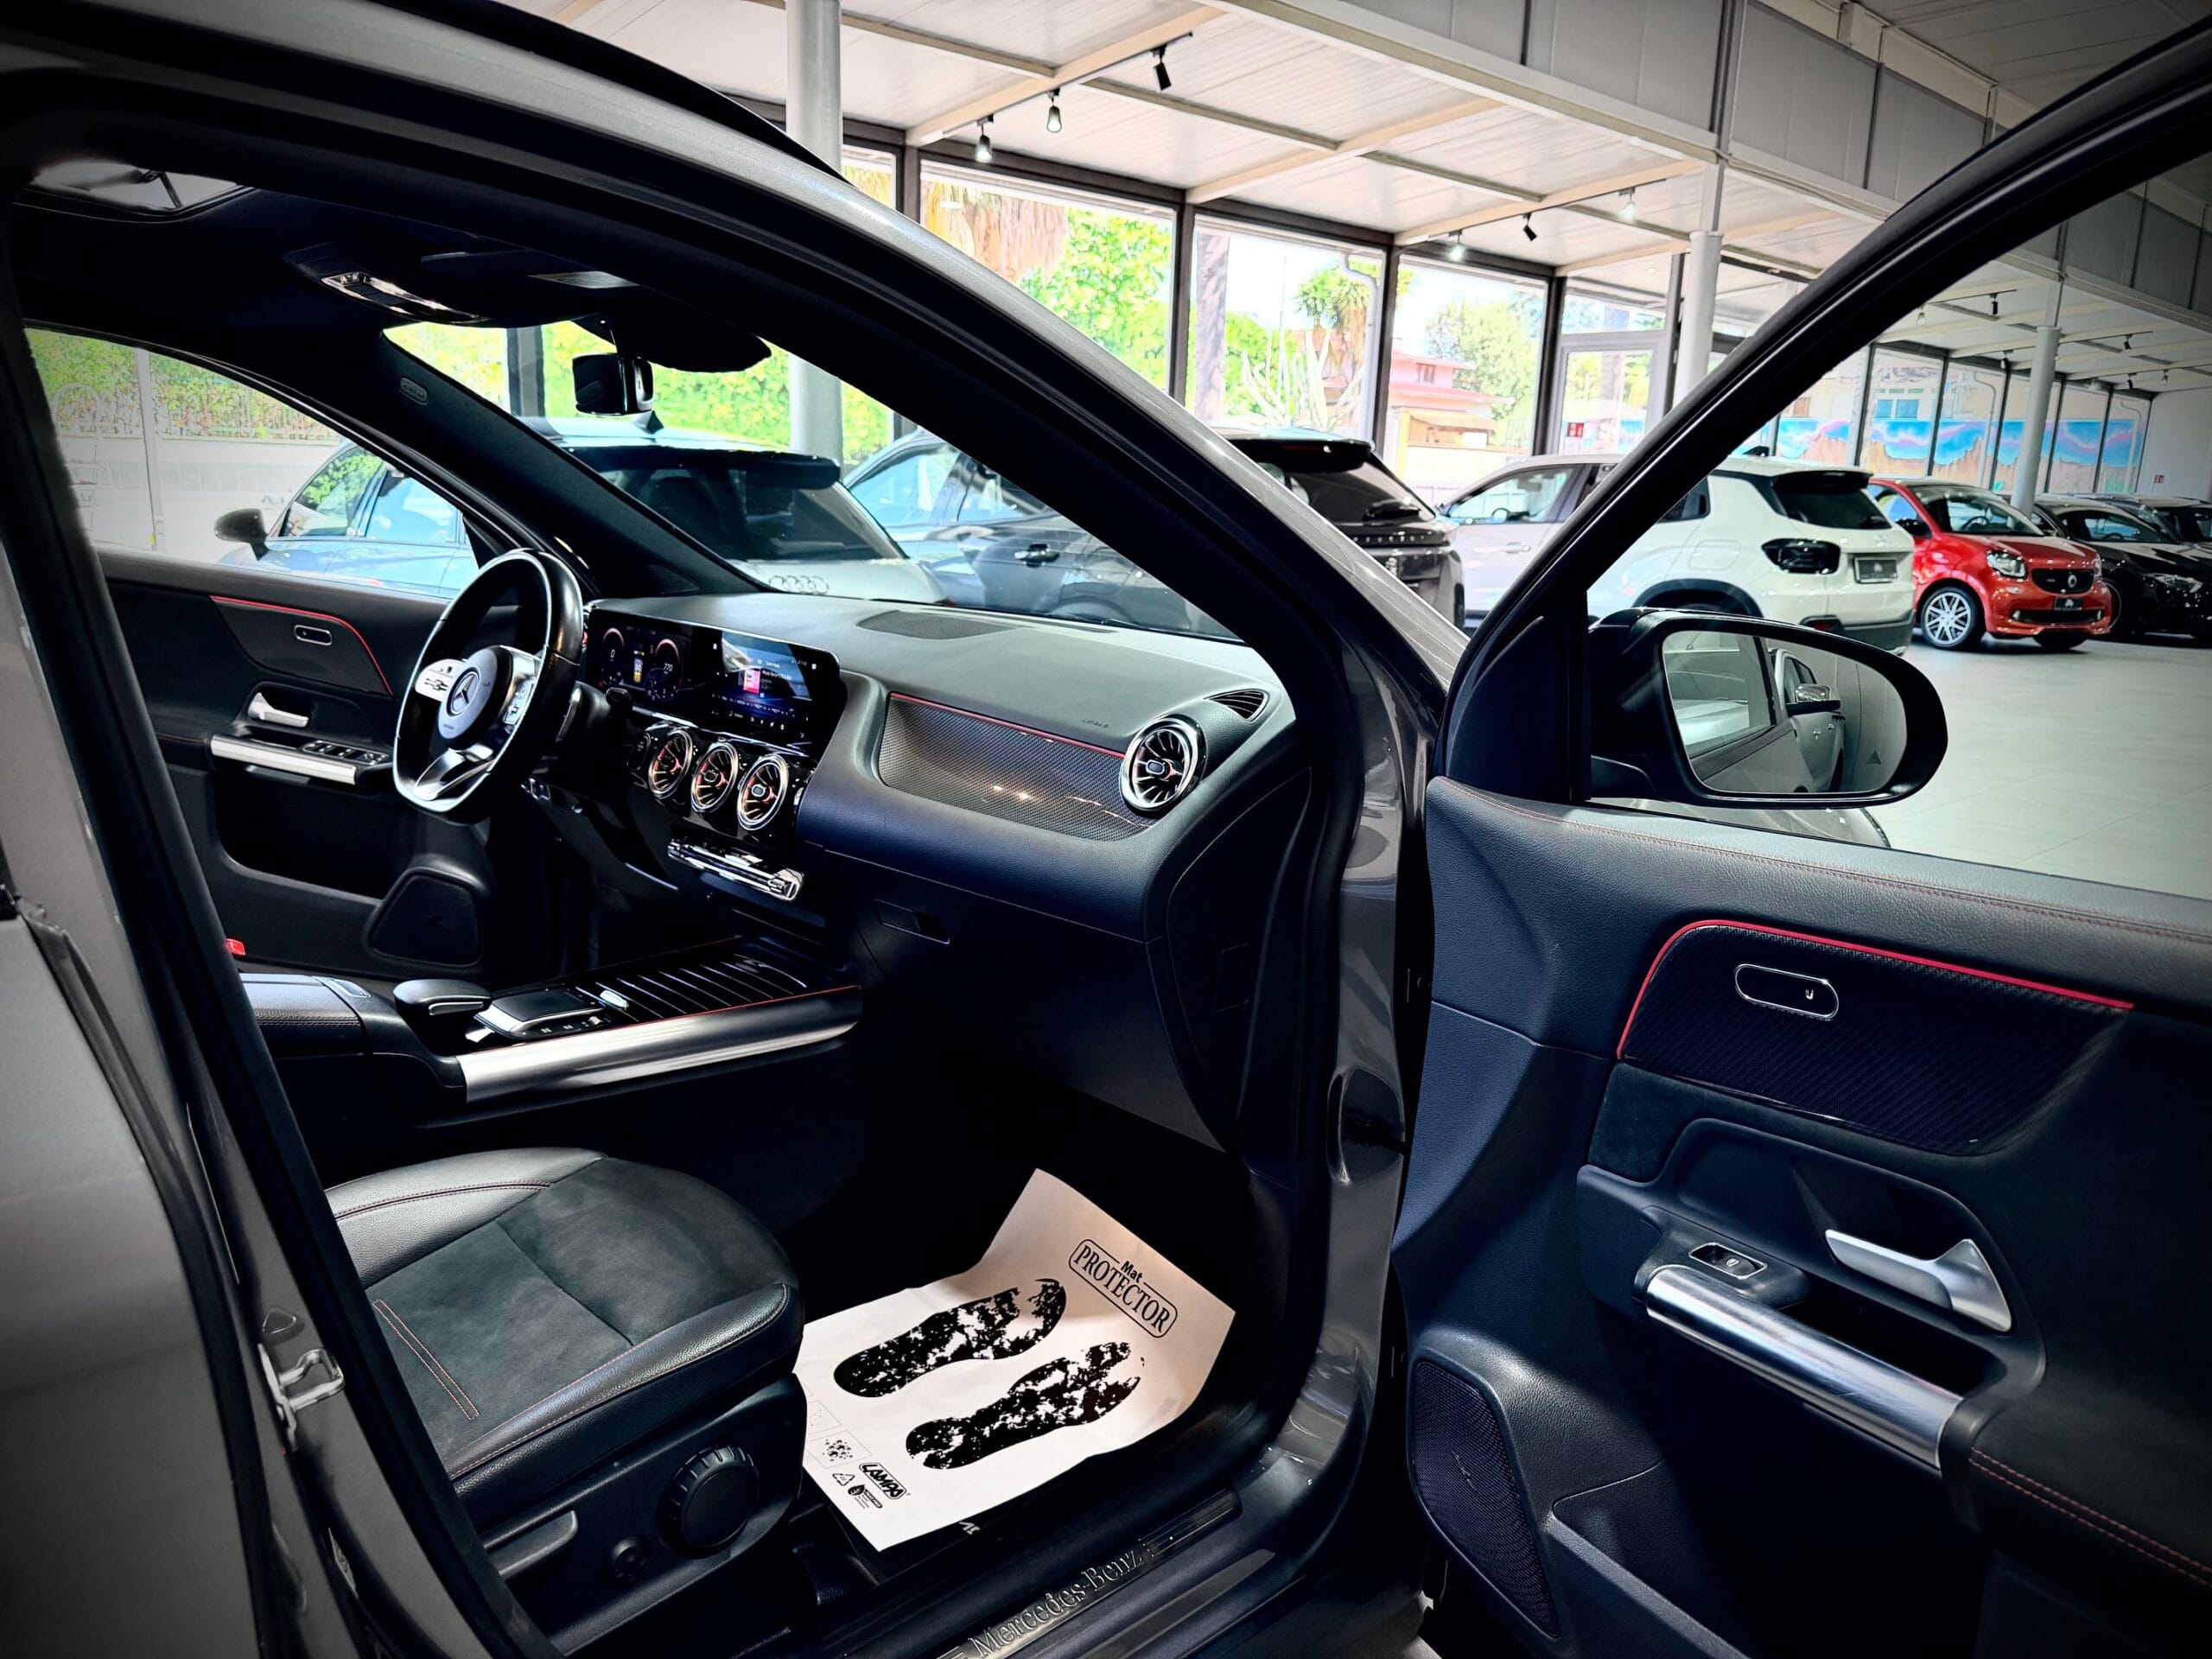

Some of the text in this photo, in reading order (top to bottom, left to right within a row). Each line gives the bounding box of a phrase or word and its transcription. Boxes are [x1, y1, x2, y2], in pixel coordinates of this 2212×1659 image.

[1073, 1245, 1170, 1333] PROTECTOR
[1121, 1261, 1142, 1283] Mat
[861, 1463, 905, 1498] LAMPA
[968, 1550, 1143, 1658] Mercedes-Benz
